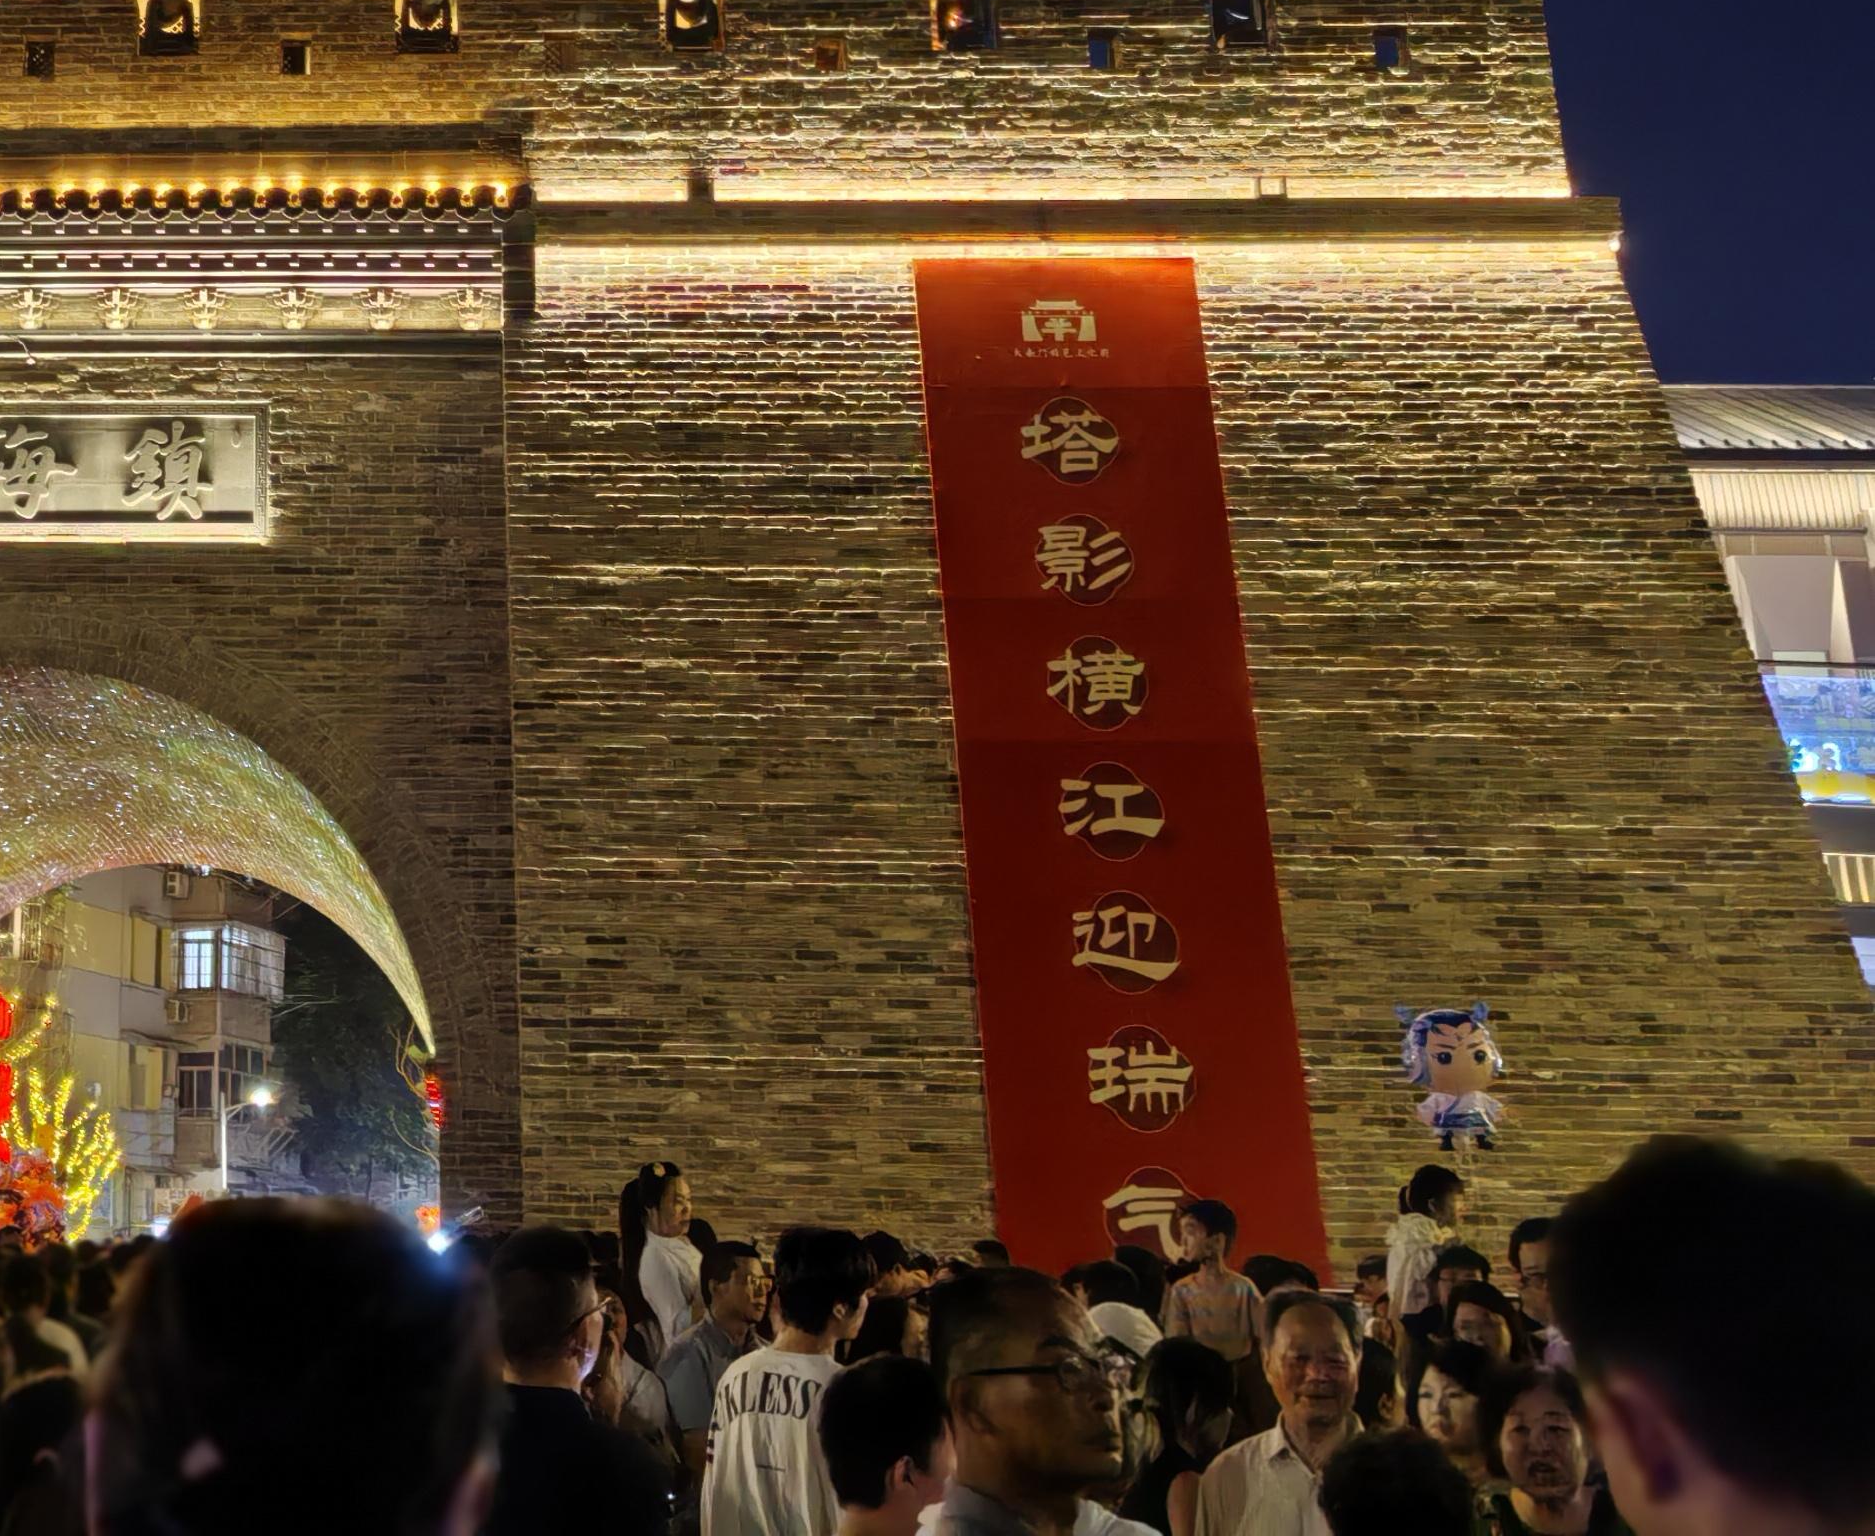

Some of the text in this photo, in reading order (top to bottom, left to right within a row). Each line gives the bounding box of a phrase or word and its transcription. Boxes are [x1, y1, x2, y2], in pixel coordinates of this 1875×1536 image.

[1021, 411, 1193, 1261] 塔影横江迎瑞气
